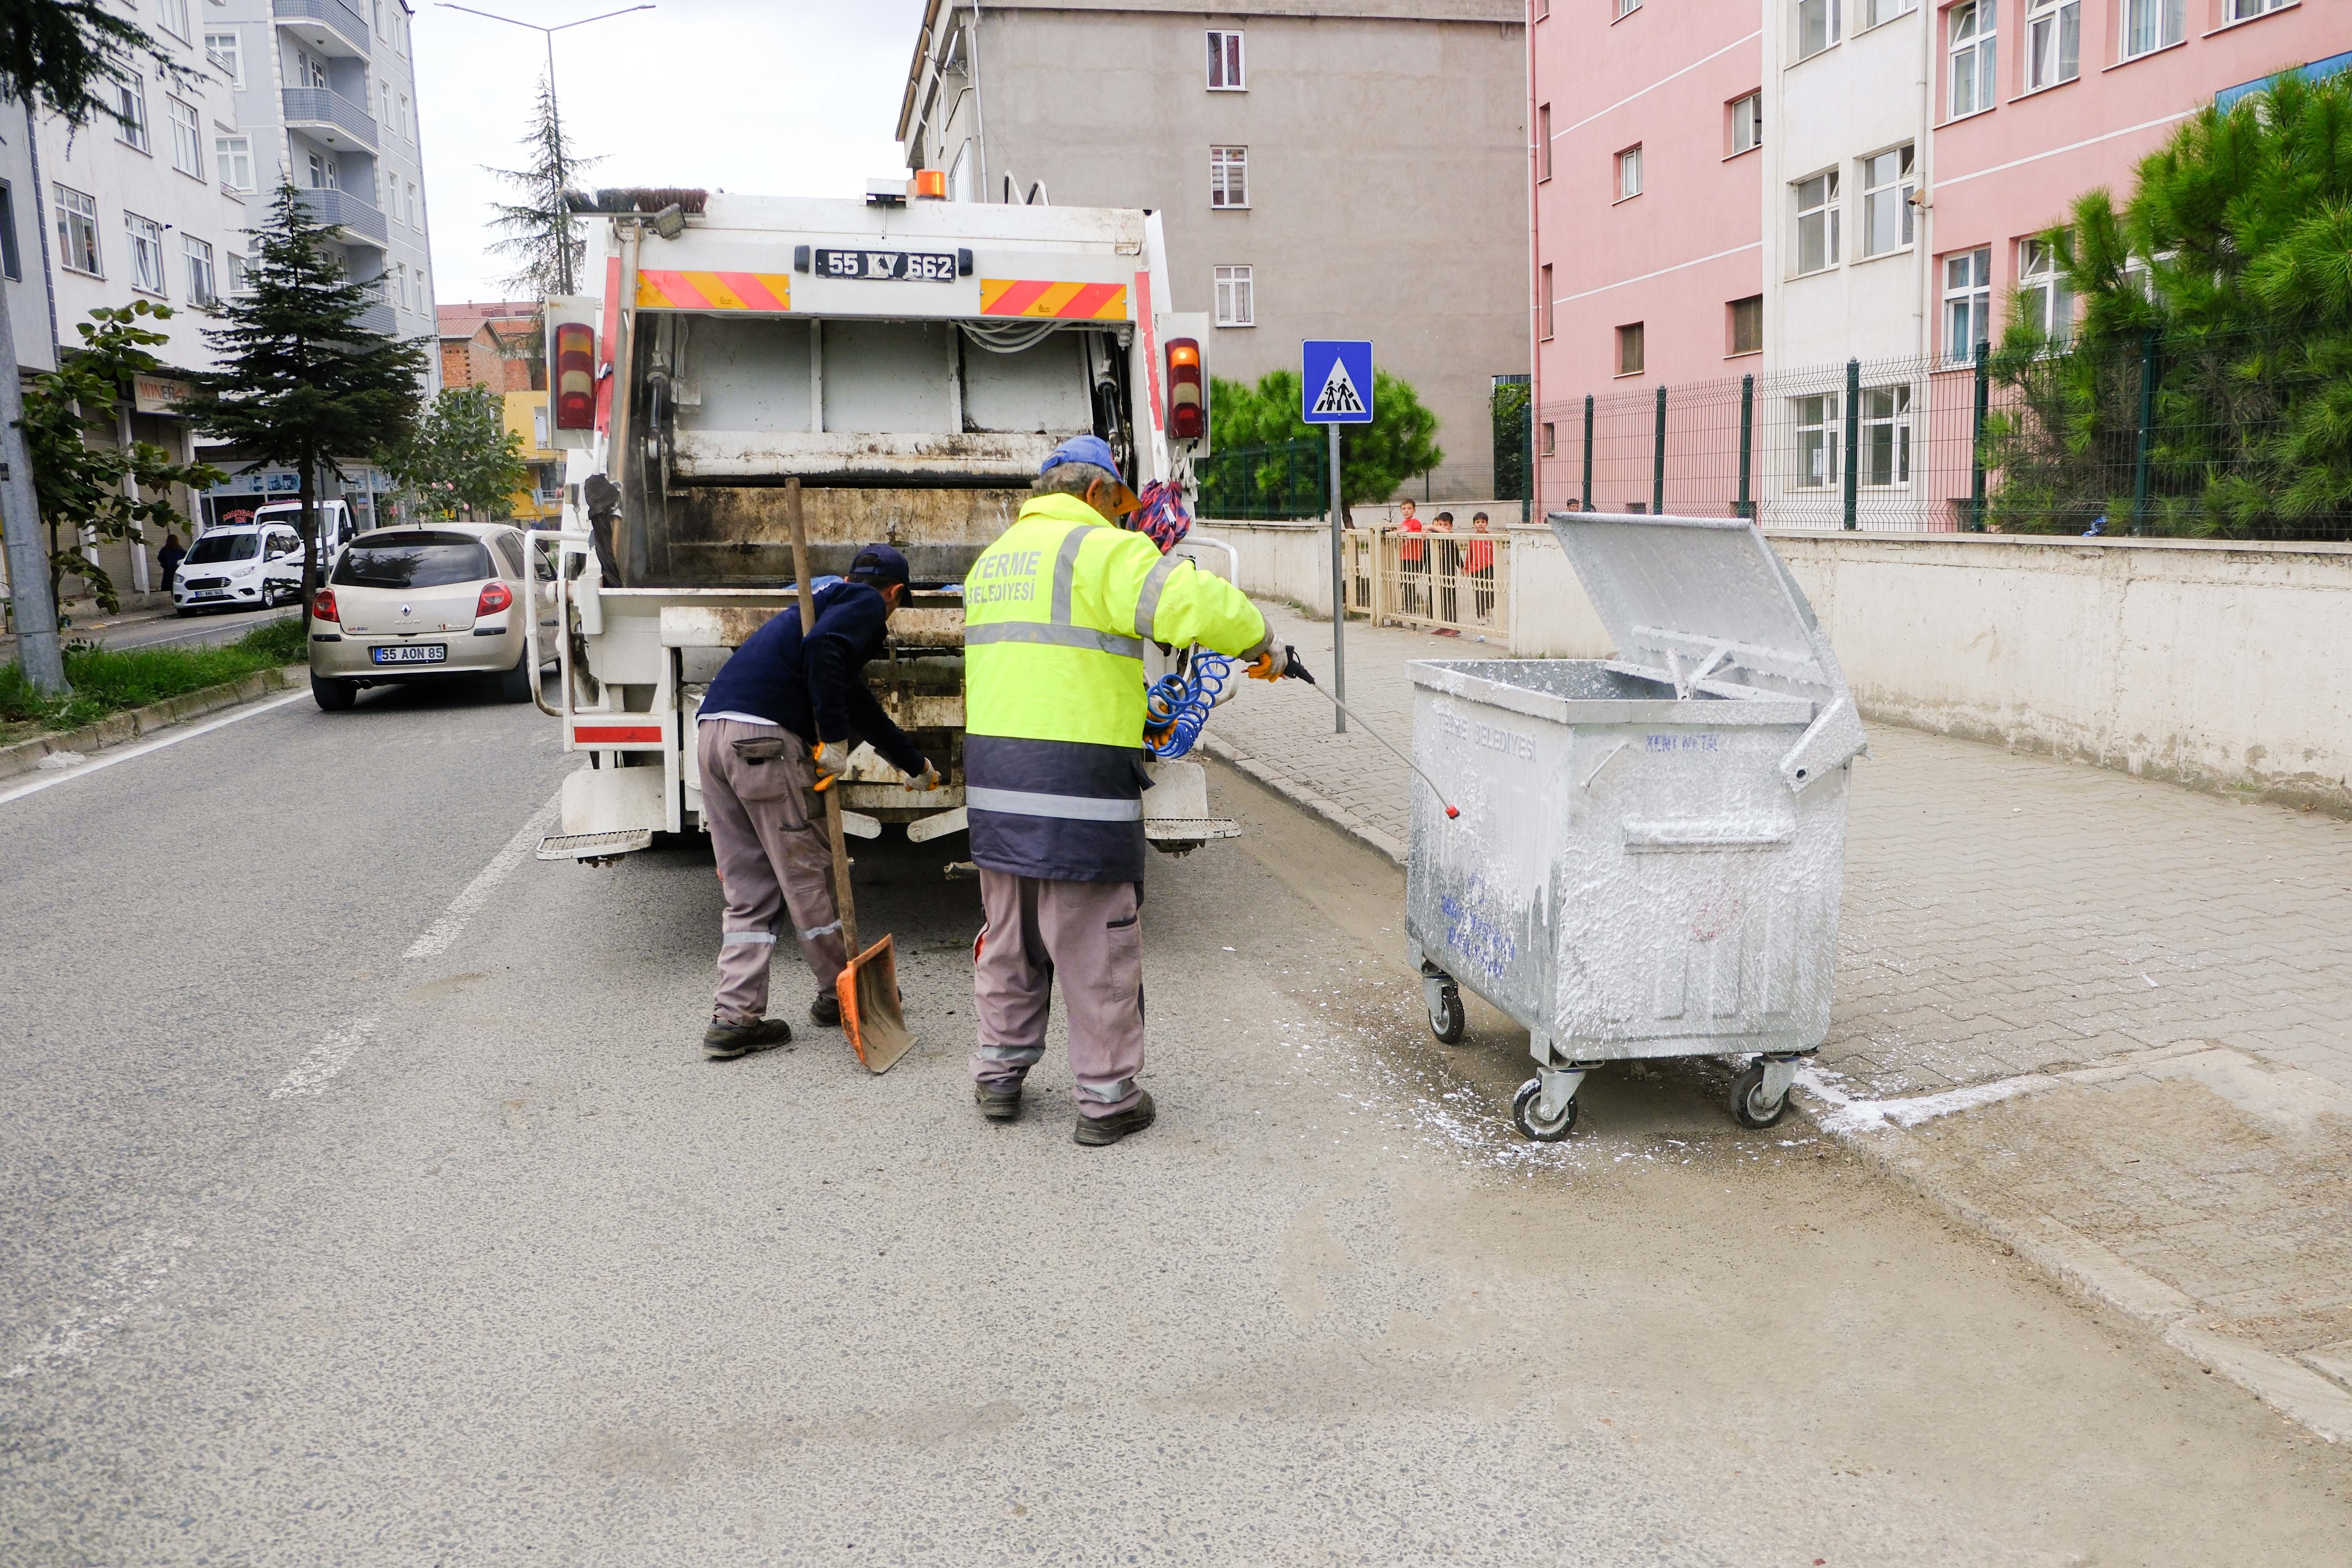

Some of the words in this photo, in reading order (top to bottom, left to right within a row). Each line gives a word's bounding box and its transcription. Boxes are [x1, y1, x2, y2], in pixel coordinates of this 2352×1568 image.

[829, 253, 859, 275] 55
[867, 253, 899, 276] KY
[908, 256, 952, 278] 662
[974, 551, 1042, 580] TERME
[967, 578, 1035, 604] BELEDİYESİ
[382, 649, 397, 660] 55
[401, 648, 424, 659] AON
[428, 648, 443, 658] 85
[1475, 726, 1536, 762] BELEDİYESİ
